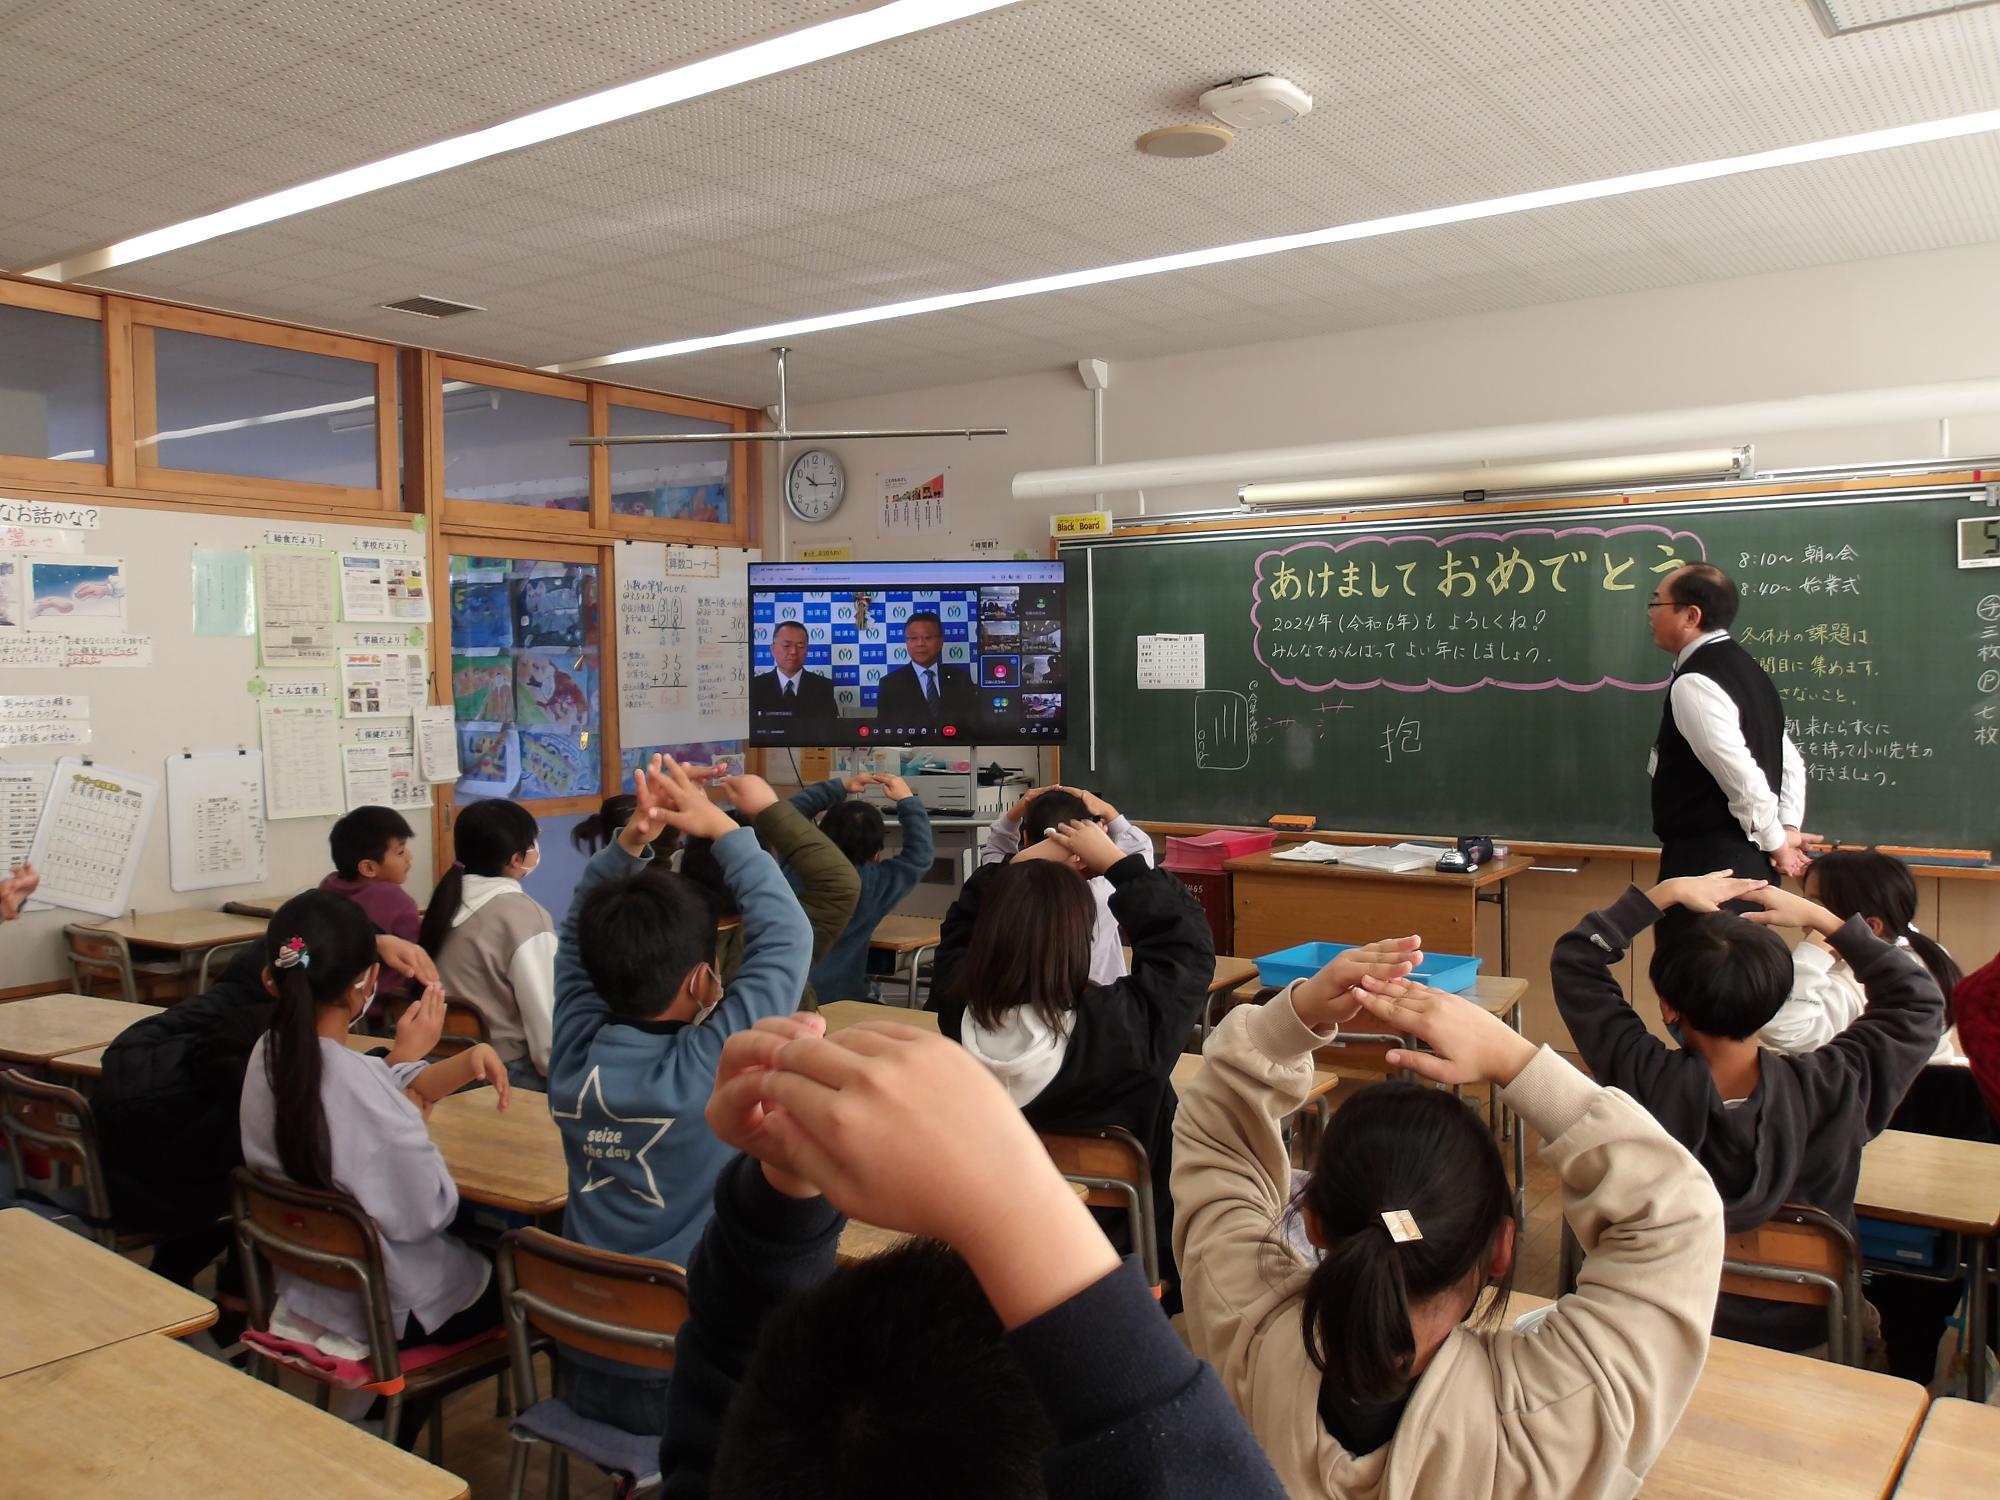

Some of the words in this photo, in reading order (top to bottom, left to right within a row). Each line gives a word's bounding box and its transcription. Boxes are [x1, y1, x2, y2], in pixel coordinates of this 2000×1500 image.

[803, 459, 809, 469] 11
[811, 455, 818, 464] 12
[822, 458, 826, 466] 1
[797, 469, 804, 478] 10
[828, 465, 835, 475] 2
[794, 482, 800, 490] 9
[832, 477, 837, 487] 3
[797, 495, 803, 504] 8
[828, 491, 834, 500] 4
[804, 503, 810, 512] 7
[813, 504, 819, 514] 6
[823, 501, 829, 511] 5
[1057, 522, 1075, 532] Black
[1079, 520, 1100, 530] Board
[273, 534, 316, 544] 給食だより
[362, 541, 400, 550] 学校だより
[975, 541, 994, 549] 時間割
[1800, 543, 1859, 563] 朝の会
[669, 559, 717, 570] 算数コーナー
[1269, 560, 1417, 601] あけまして
[1800, 573, 1861, 597] 始業式
[1272, 612, 1436, 633] 2024年(令和6年)も
[834, 629, 856, 637] 加須市
[1740, 623, 1868, 645] 冬休みの課題は
[363, 635, 401, 644] 学級だより
[277, 686, 320, 695] こん立て表
[365, 730, 402, 739] 保健だより
[1380, 716, 1422, 763] 抱
[586, 1127, 623, 1144] seize
[583, 1144, 602, 1158] the
[606, 1145, 631, 1160] day
